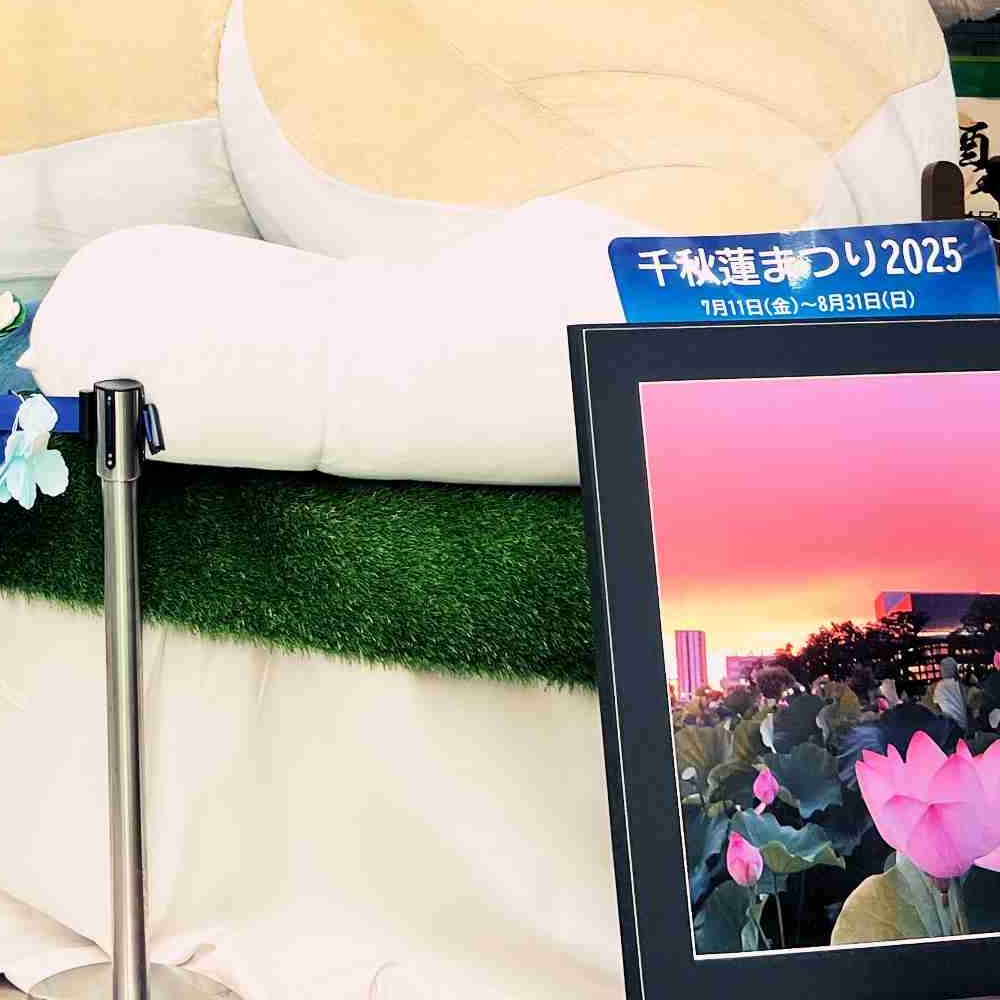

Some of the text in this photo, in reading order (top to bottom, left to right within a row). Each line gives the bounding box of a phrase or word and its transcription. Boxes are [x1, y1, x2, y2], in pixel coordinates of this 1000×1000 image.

[637, 236, 964, 288] 千秋蓮まつり2025
